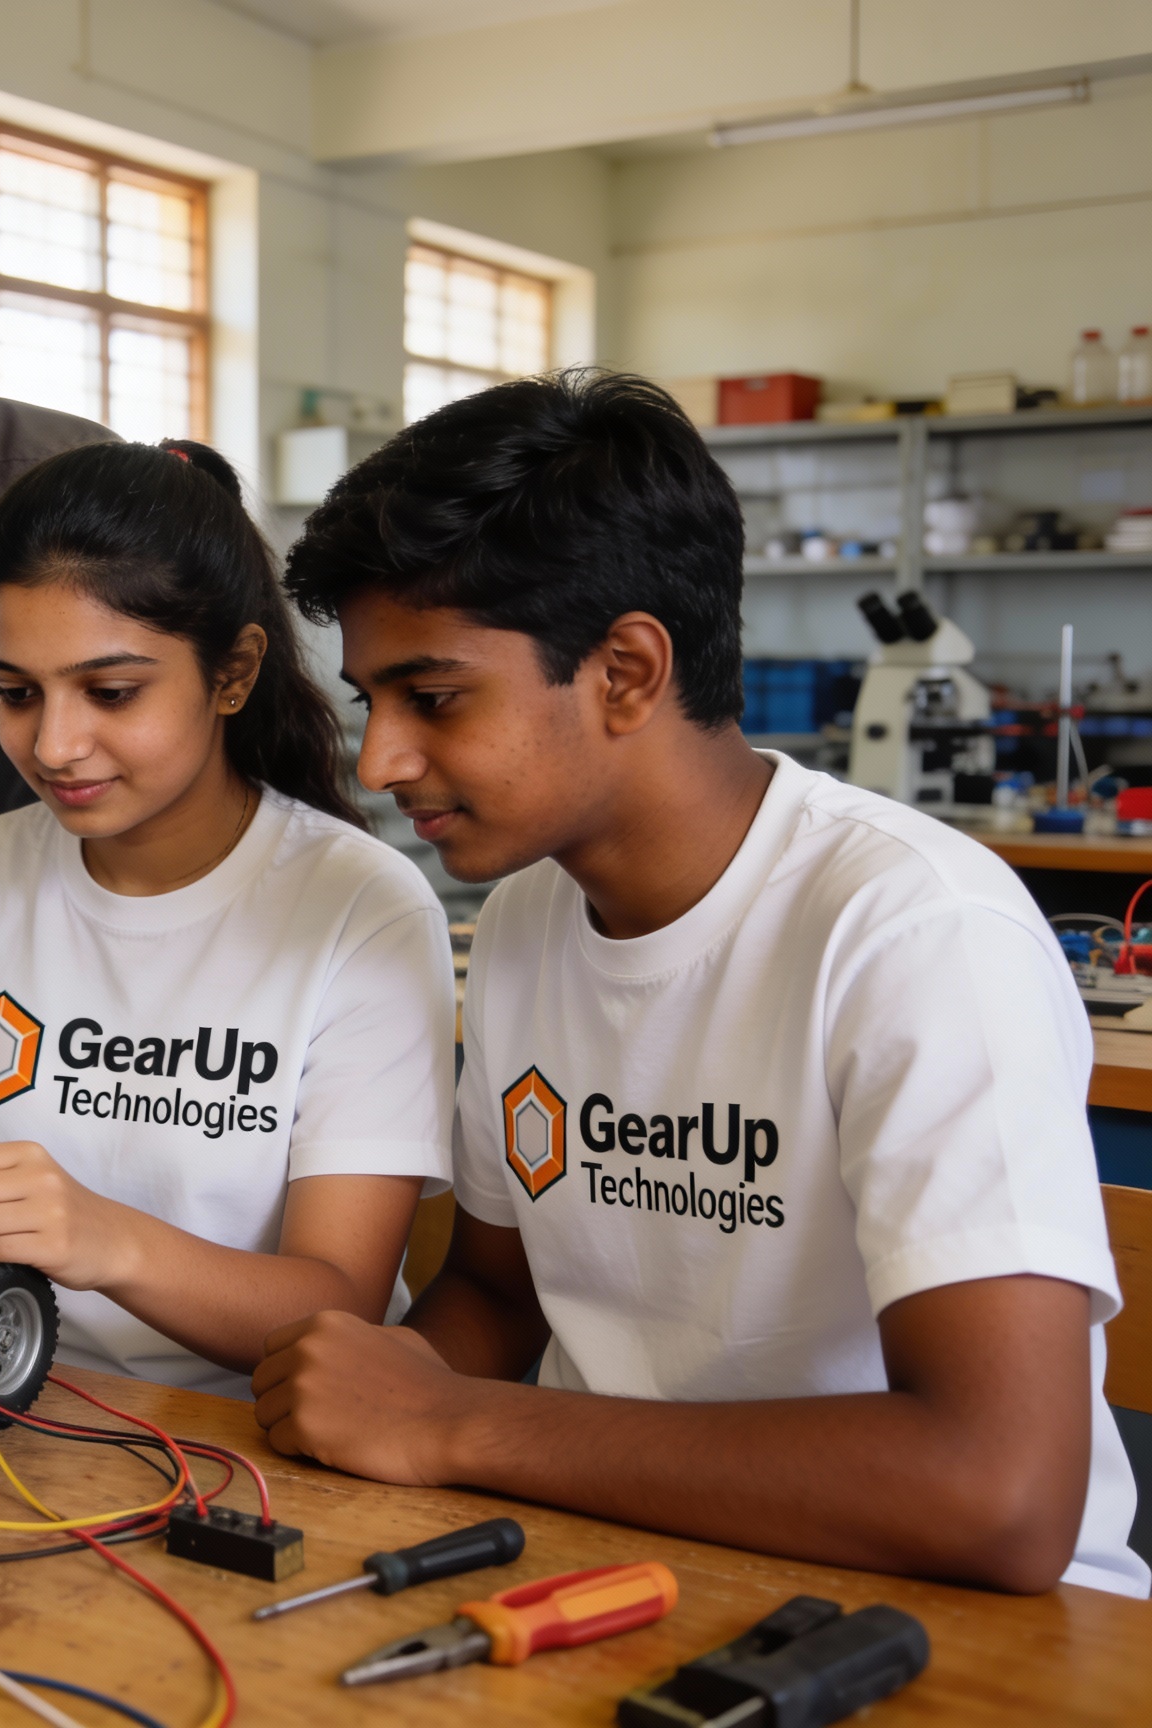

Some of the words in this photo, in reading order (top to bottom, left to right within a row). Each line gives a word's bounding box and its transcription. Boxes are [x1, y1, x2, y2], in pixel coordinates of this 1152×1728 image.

[58, 1017, 279, 1096] GearUp
[53, 1075, 278, 1140] Technologies
[579, 1092, 780, 1184] GearUp
[580, 1160, 786, 1235] Technologies
